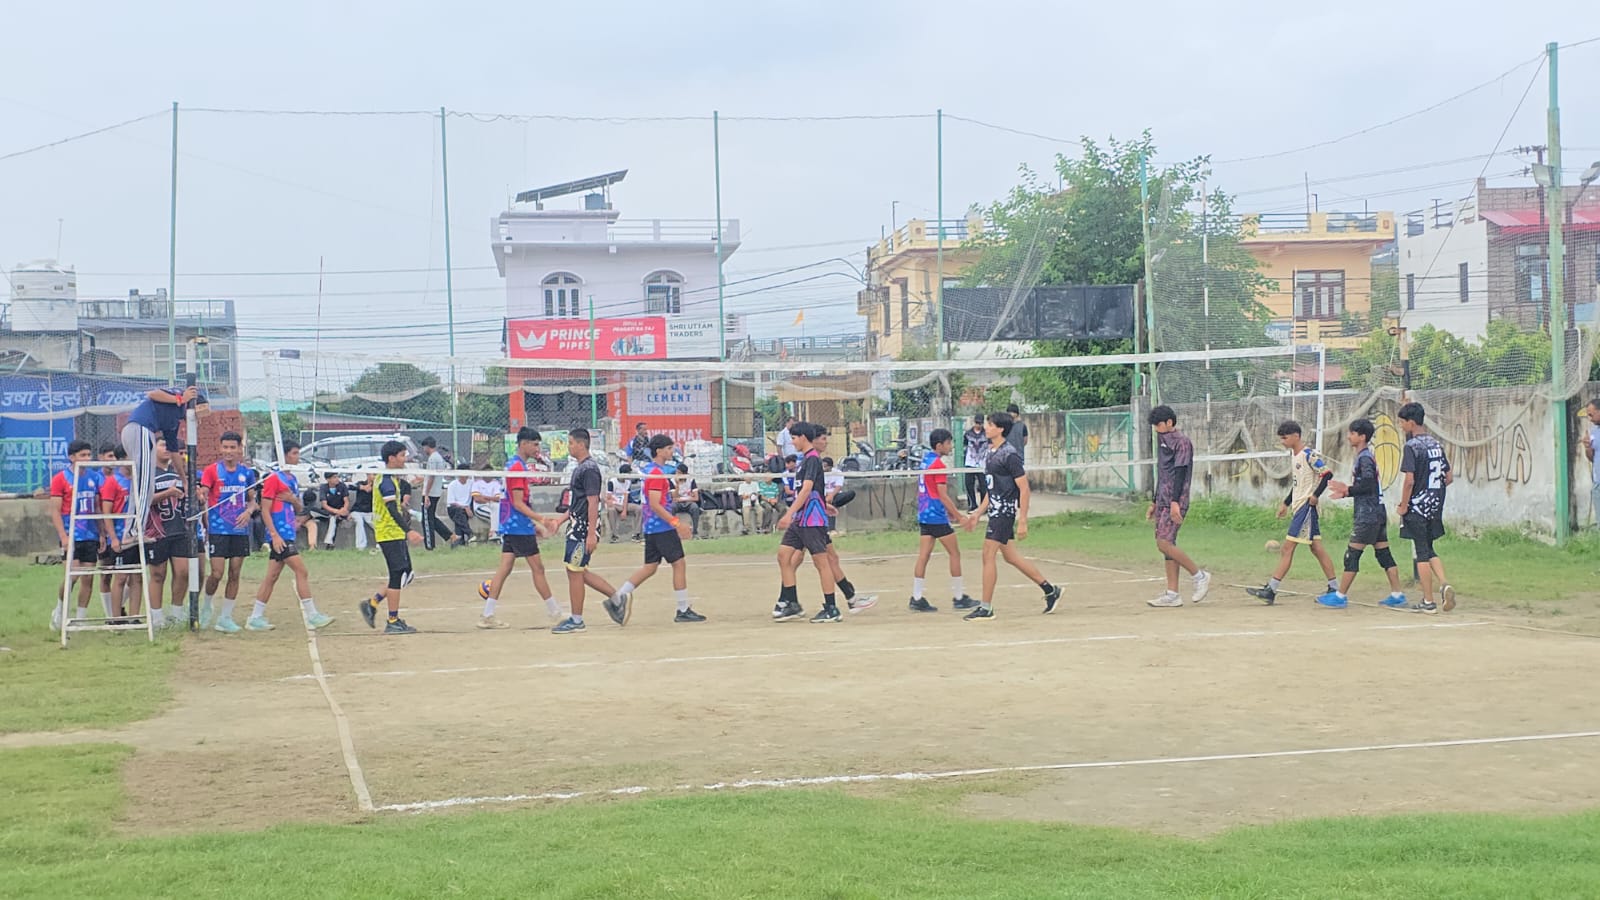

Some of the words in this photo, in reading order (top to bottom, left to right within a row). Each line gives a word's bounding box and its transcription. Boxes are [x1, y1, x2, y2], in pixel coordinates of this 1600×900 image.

[550, 328, 601, 341] PRINCE
[669, 330, 704, 338] TRADERS
[559, 341, 590, 350] PIPES
[647, 393, 691, 403] CEMENT
[1429, 460, 1441, 489] 2
